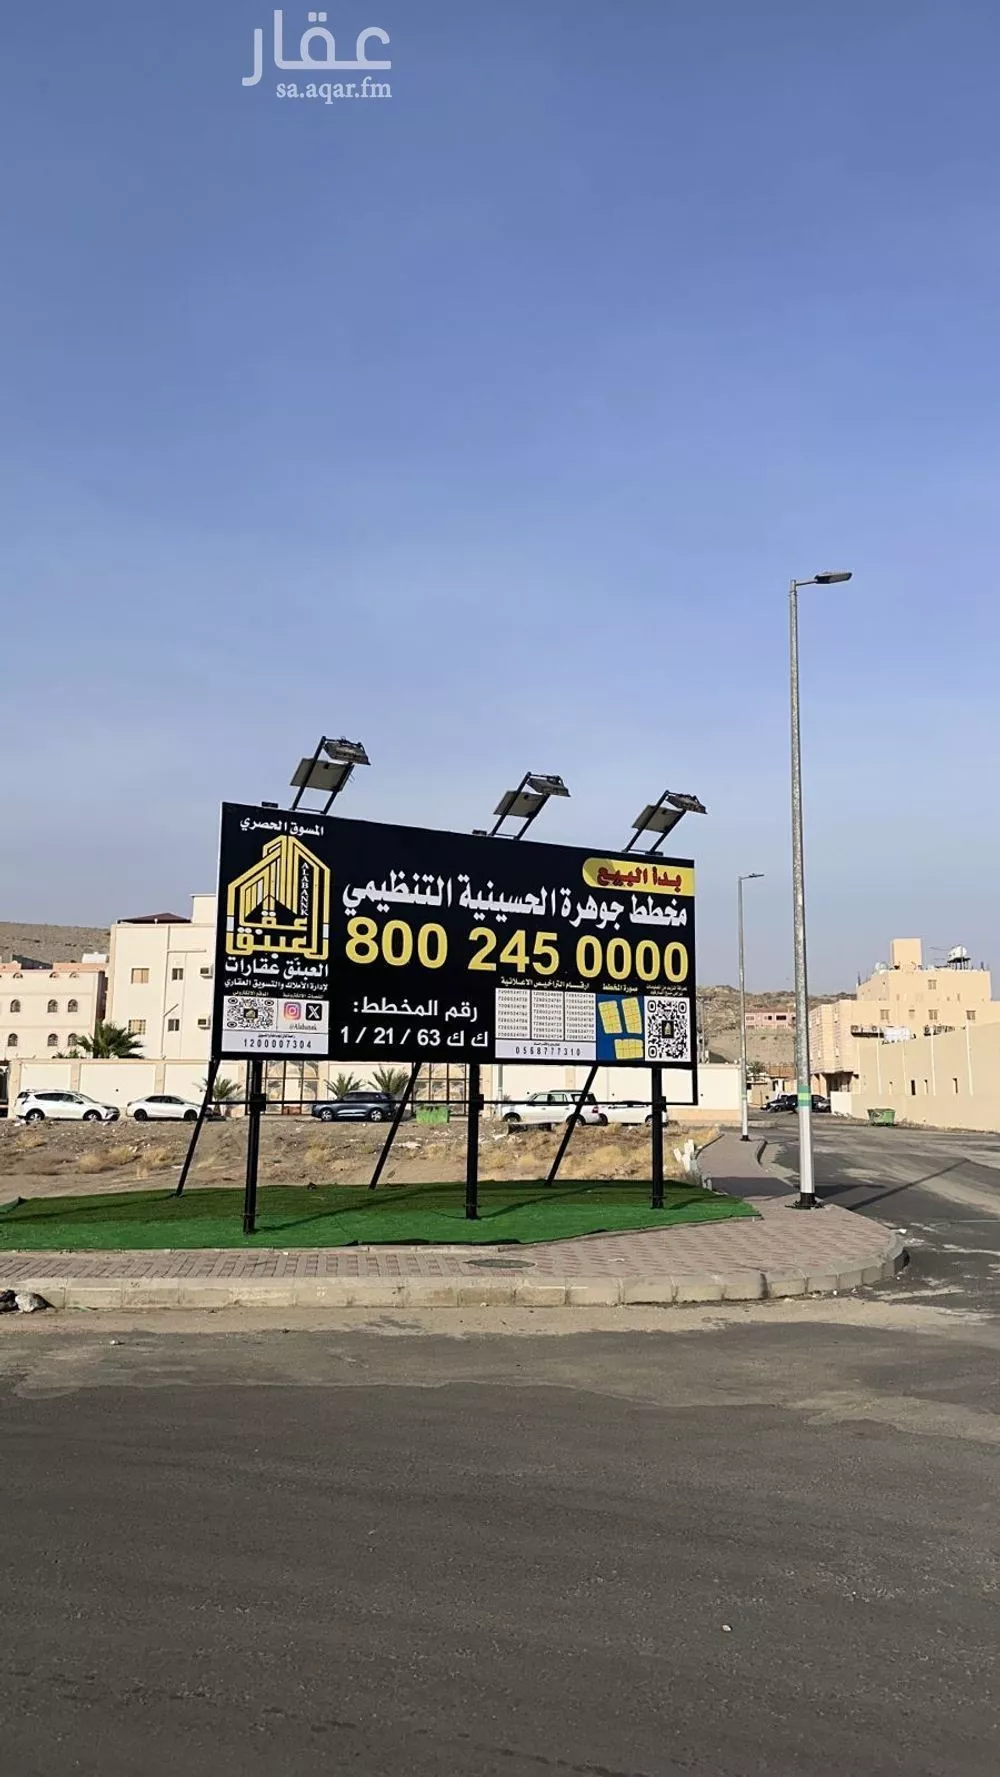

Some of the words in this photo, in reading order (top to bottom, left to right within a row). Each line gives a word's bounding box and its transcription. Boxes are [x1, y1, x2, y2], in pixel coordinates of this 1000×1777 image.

[240, 817, 288, 831] الحصري
[289, 821, 324, 836] المسوق
[597, 867, 648, 887] البيع
[652, 866, 682, 893] بدأ
[300, 862, 309, 916] ALABANNK
[342, 869, 452, 916] التنظيمي
[458, 874, 556, 923] الحسينية
[560, 887, 625, 930] جوهرة
[629, 894, 688, 927] مخطط
[346, 916, 448, 969] 800
[468, 927, 560, 975] 245
[576, 935, 689, 983] 0000
[225, 956, 280, 977] عقارات
[224, 978, 251, 989] العقاري
[353, 996, 438, 1017] المخطط:
[445, 1001, 478, 1023] رقم
[244, 1038, 312, 1049] 1200007304
[341, 1026, 349, 1044] 1
[355, 1026, 367, 1044] /
[373, 1027, 394, 1045] 21
[400, 1028, 411, 1045] /
[417, 1028, 441, 1046] 63
[447, 1030, 464, 1047] ك
[471, 1031, 488, 1047] ك
